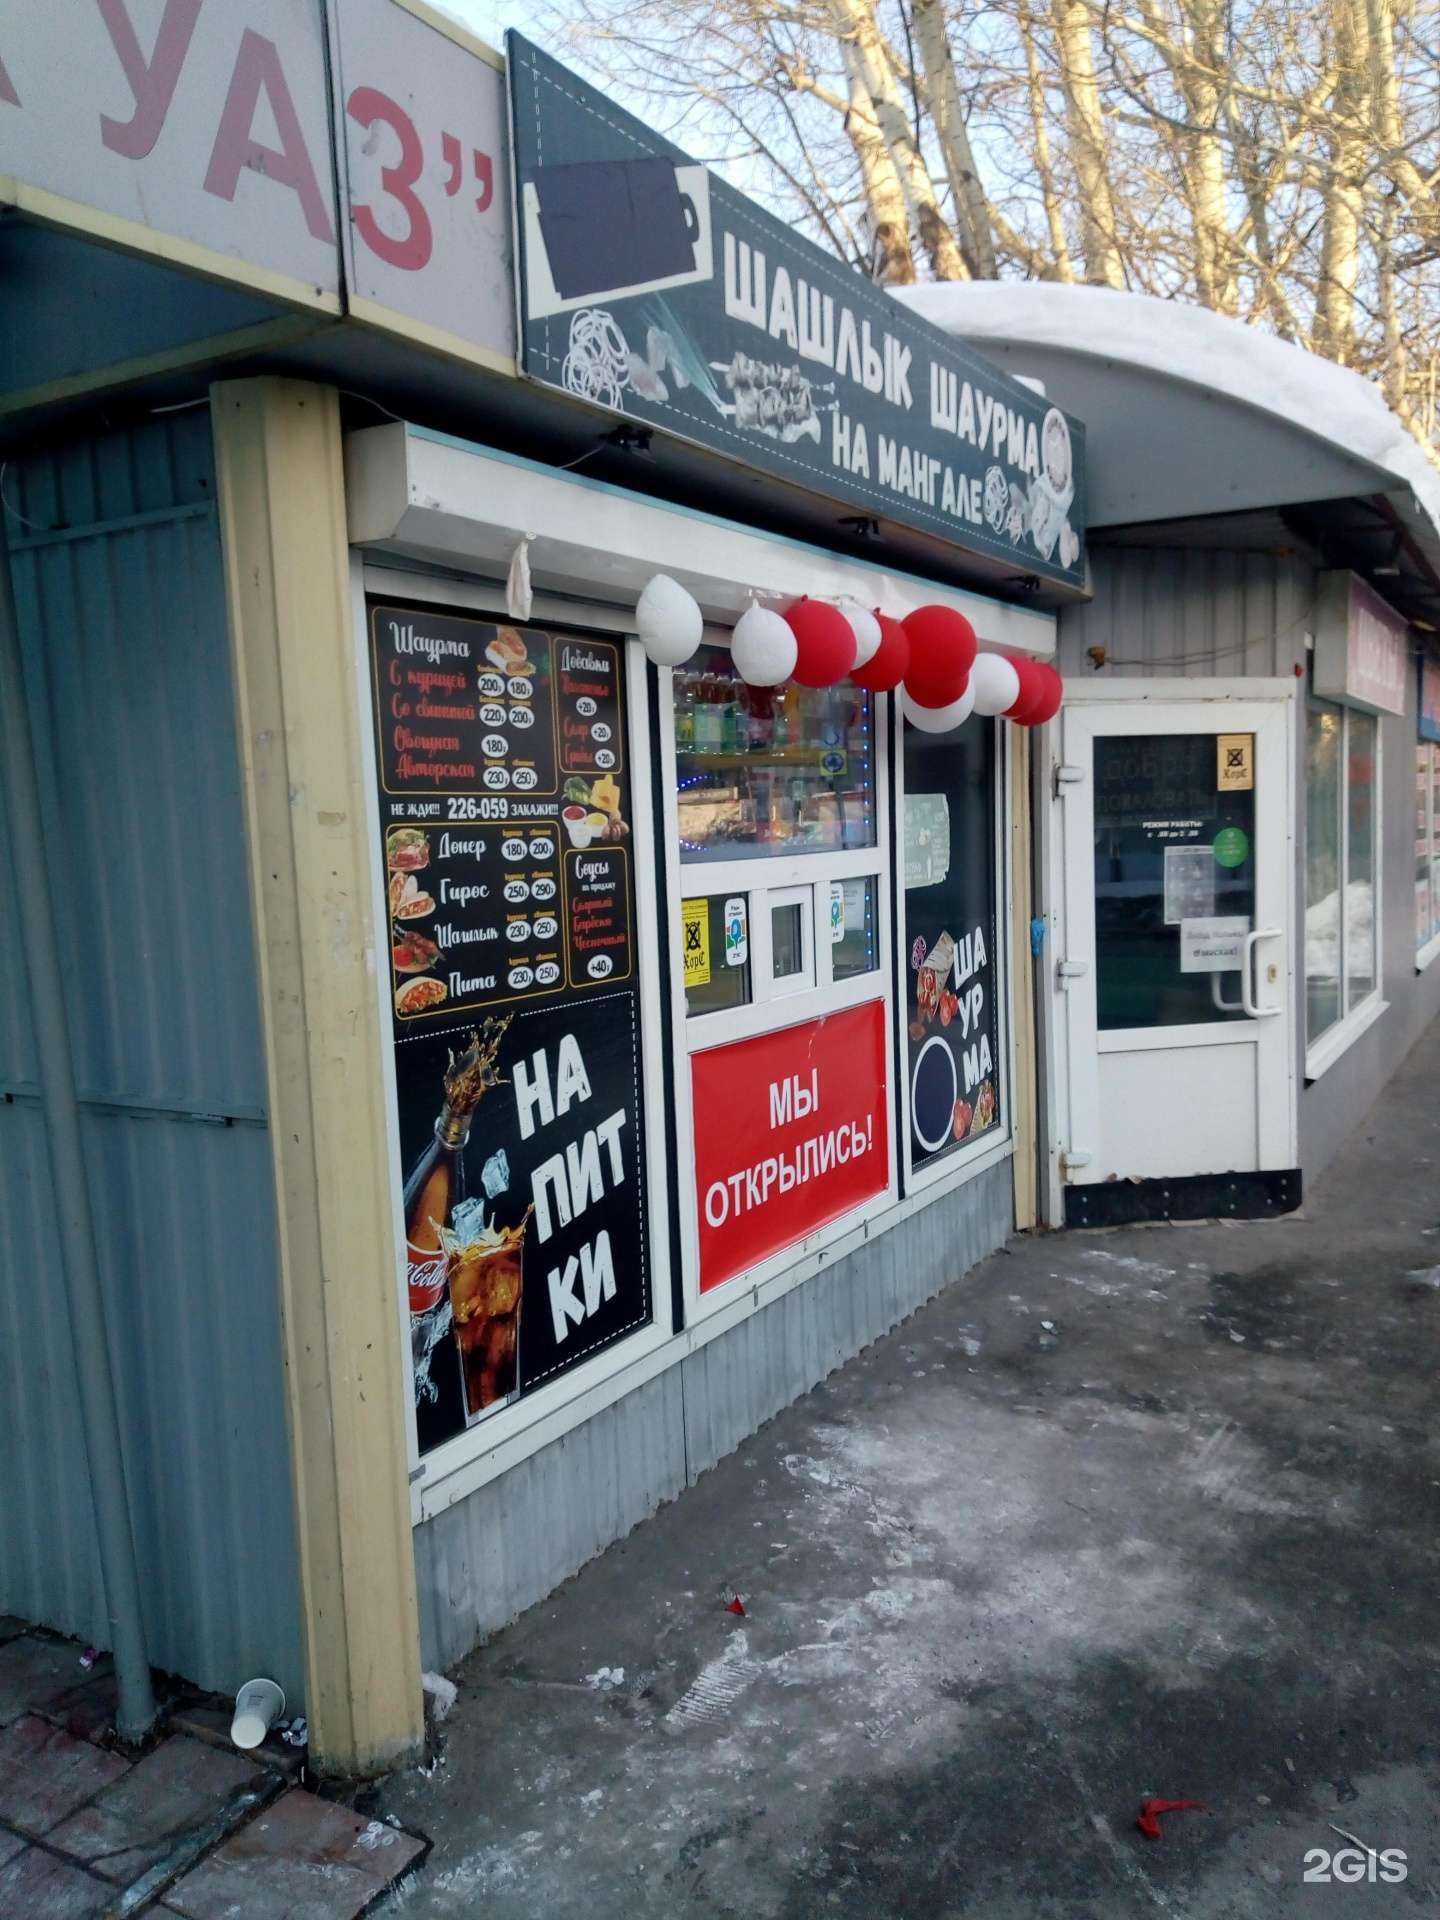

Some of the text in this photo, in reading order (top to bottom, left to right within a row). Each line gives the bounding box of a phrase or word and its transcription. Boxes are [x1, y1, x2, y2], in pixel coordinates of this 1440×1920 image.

[723, 230, 1042, 479] ШАШЛЫК ШАУРМА
[832, 407, 983, 525] НА МАНГАЛЕ
[389, 622, 471, 664] Шаурма
[561, 646, 609, 672] Добавки
[391, 797, 559, 819] НЕ ЖДИ!!! 226-059 ЗАКАЖИ!!!
[438, 832, 486, 861] Донер
[576, 855, 609, 882] Соусы
[440, 878, 490, 908] Гирос
[434, 923, 499, 949] Шашлык
[953, 926, 987, 991] ША
[449, 971, 497, 998] Пита
[957, 982, 984, 1040] УР
[512, 1033, 592, 1141] НА
[962, 1033, 993, 1094] МА
[769, 1067, 819, 1130] МЫ
[530, 1107, 626, 1245] ПИТ
[705, 1113, 873, 1228] ОТКРЫЛИСЬ!
[547, 1229, 617, 1344] КИ
